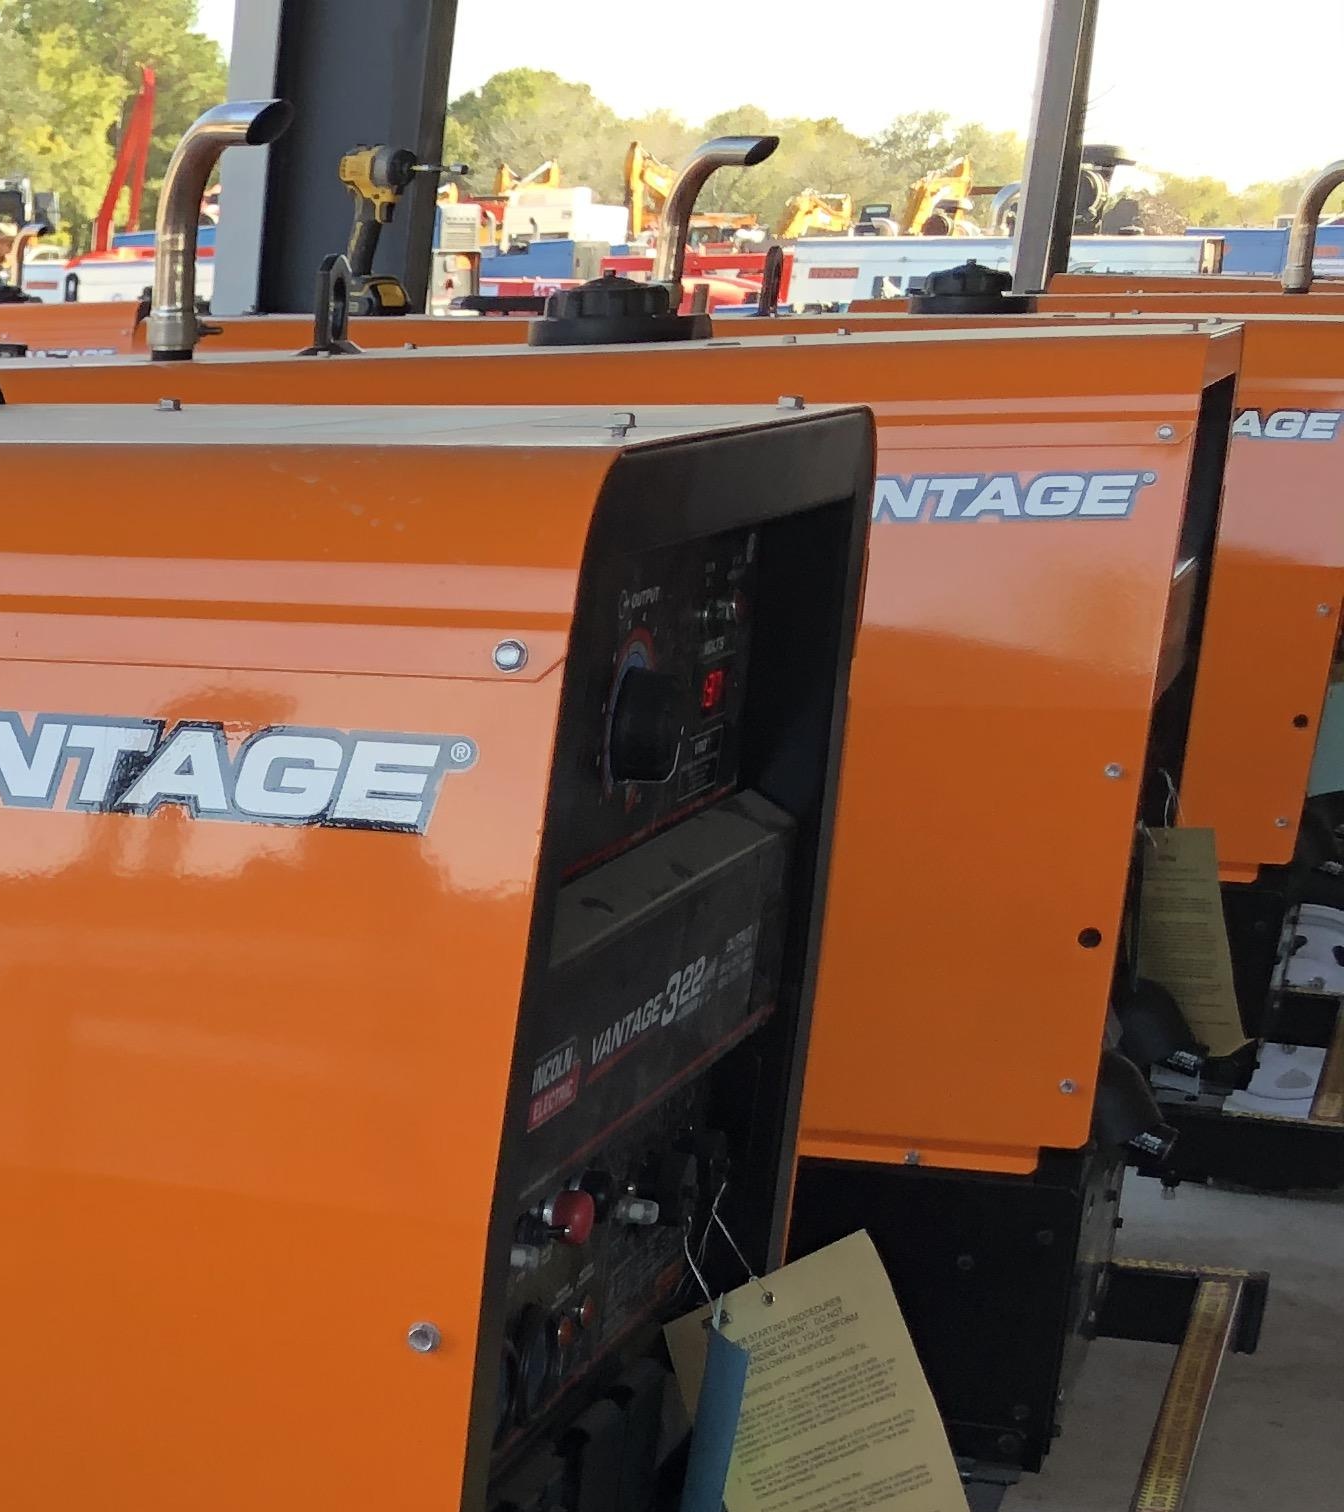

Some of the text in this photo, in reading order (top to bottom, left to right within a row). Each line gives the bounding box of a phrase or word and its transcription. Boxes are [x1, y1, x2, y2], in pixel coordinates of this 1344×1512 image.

[872, 474, 1137, 520] NTAGE
[591, 992, 663, 1066] VANTAGE
[660, 955, 706, 1027] 322
[531, 1046, 574, 1095] INCOLN
